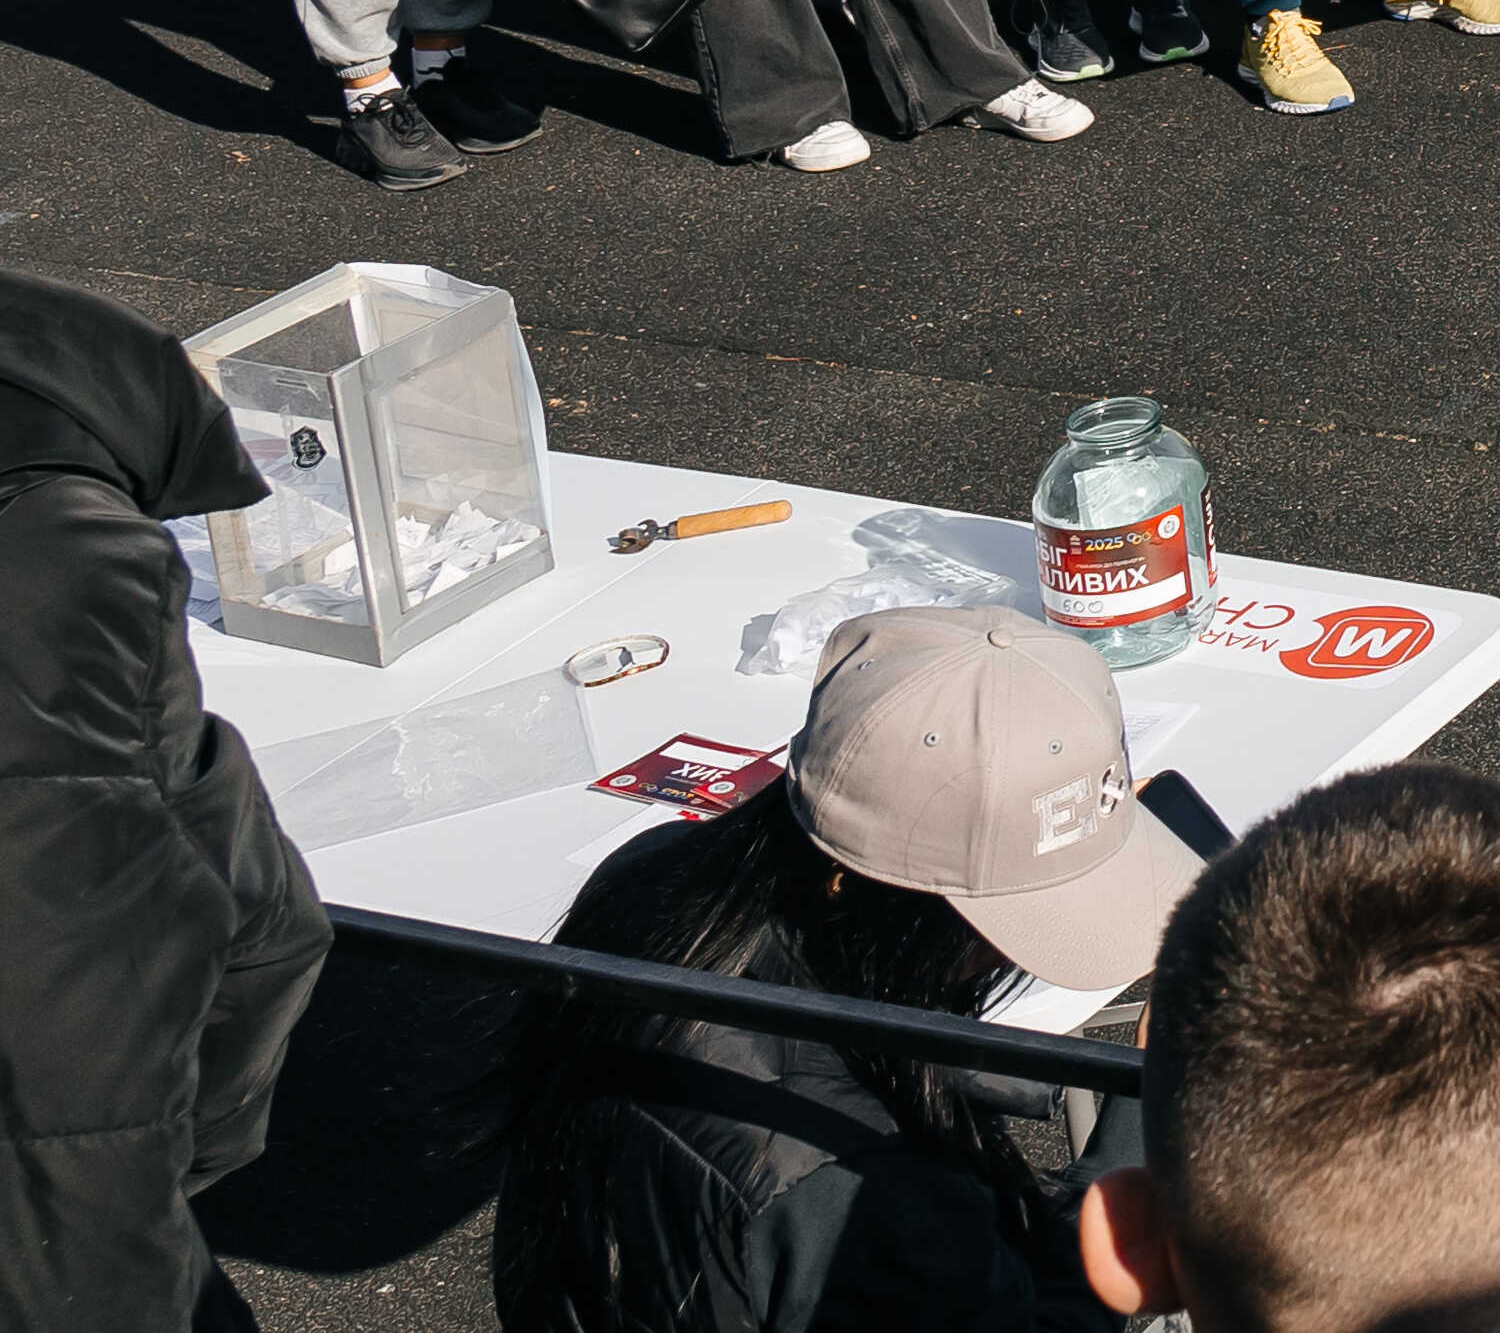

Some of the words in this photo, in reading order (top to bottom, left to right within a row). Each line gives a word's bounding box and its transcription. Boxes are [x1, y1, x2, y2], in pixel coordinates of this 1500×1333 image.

[1039, 540, 1068, 567] БІГ
[1084, 535, 1125, 552] 2025
[1044, 564, 1150, 594] ІЛИВИХ
[1216, 597, 1296, 630] CH
